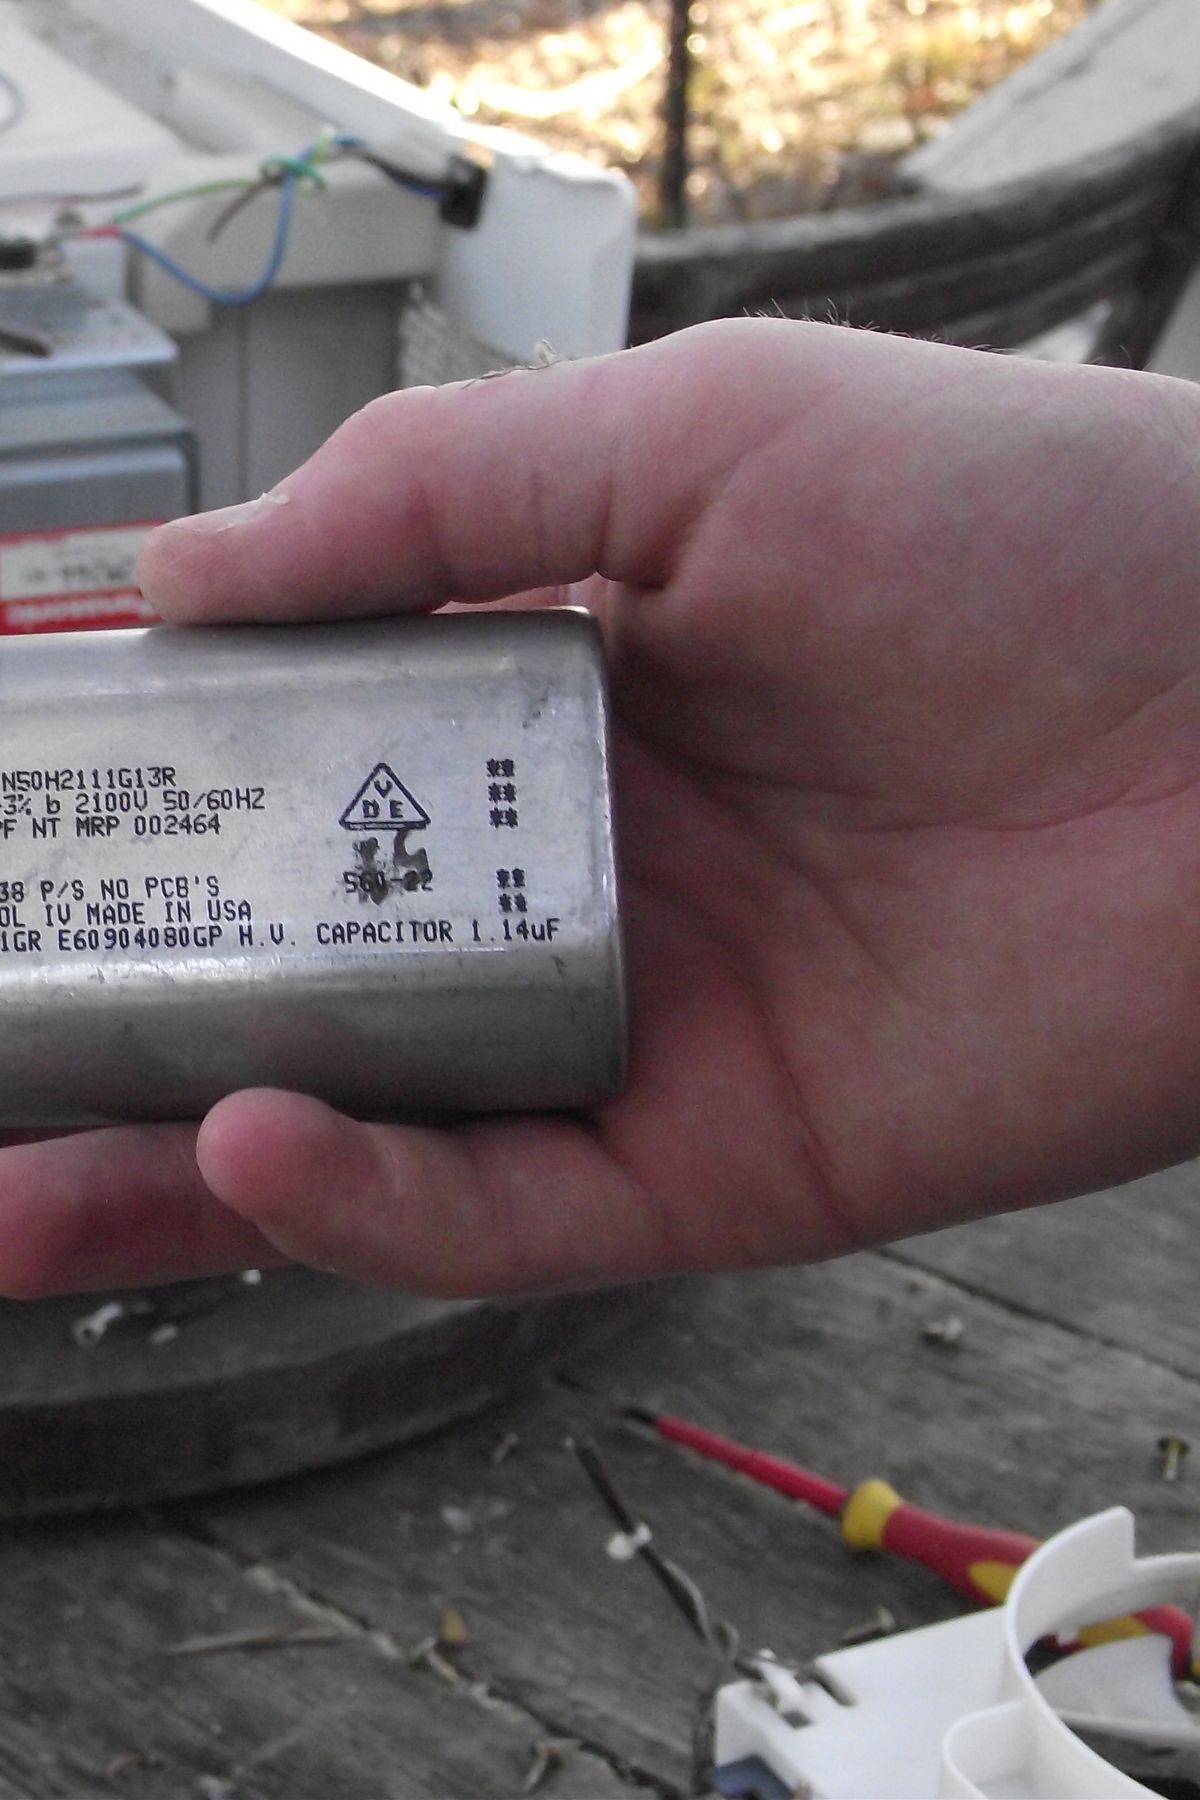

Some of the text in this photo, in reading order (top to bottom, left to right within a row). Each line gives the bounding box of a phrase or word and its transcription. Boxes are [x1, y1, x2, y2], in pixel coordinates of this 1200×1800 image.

[2, 767, 176, 792] N50H2111G13R
[76, 791, 148, 813] 2100V
[163, 788, 266, 810] 50/60HZ
[33, 818, 60, 838] NT
[76, 816, 120, 837] MRP
[134, 814, 221, 835] 002464
[40, 880, 85, 901] P/S
[101, 878, 129, 899] NO
[145, 876, 220, 898] PCB'S
[46, 904, 70, 926] IV
[86, 902, 145, 924] MADE
[165, 901, 191, 923] IN
[208, 899, 252, 921] USA
[58, 925, 222, 951] E60904080GP
[238, 923, 296, 947] H.V.
[317, 921, 454, 945] CAPACITOR
[472, 918, 561, 941] 1.14uF
